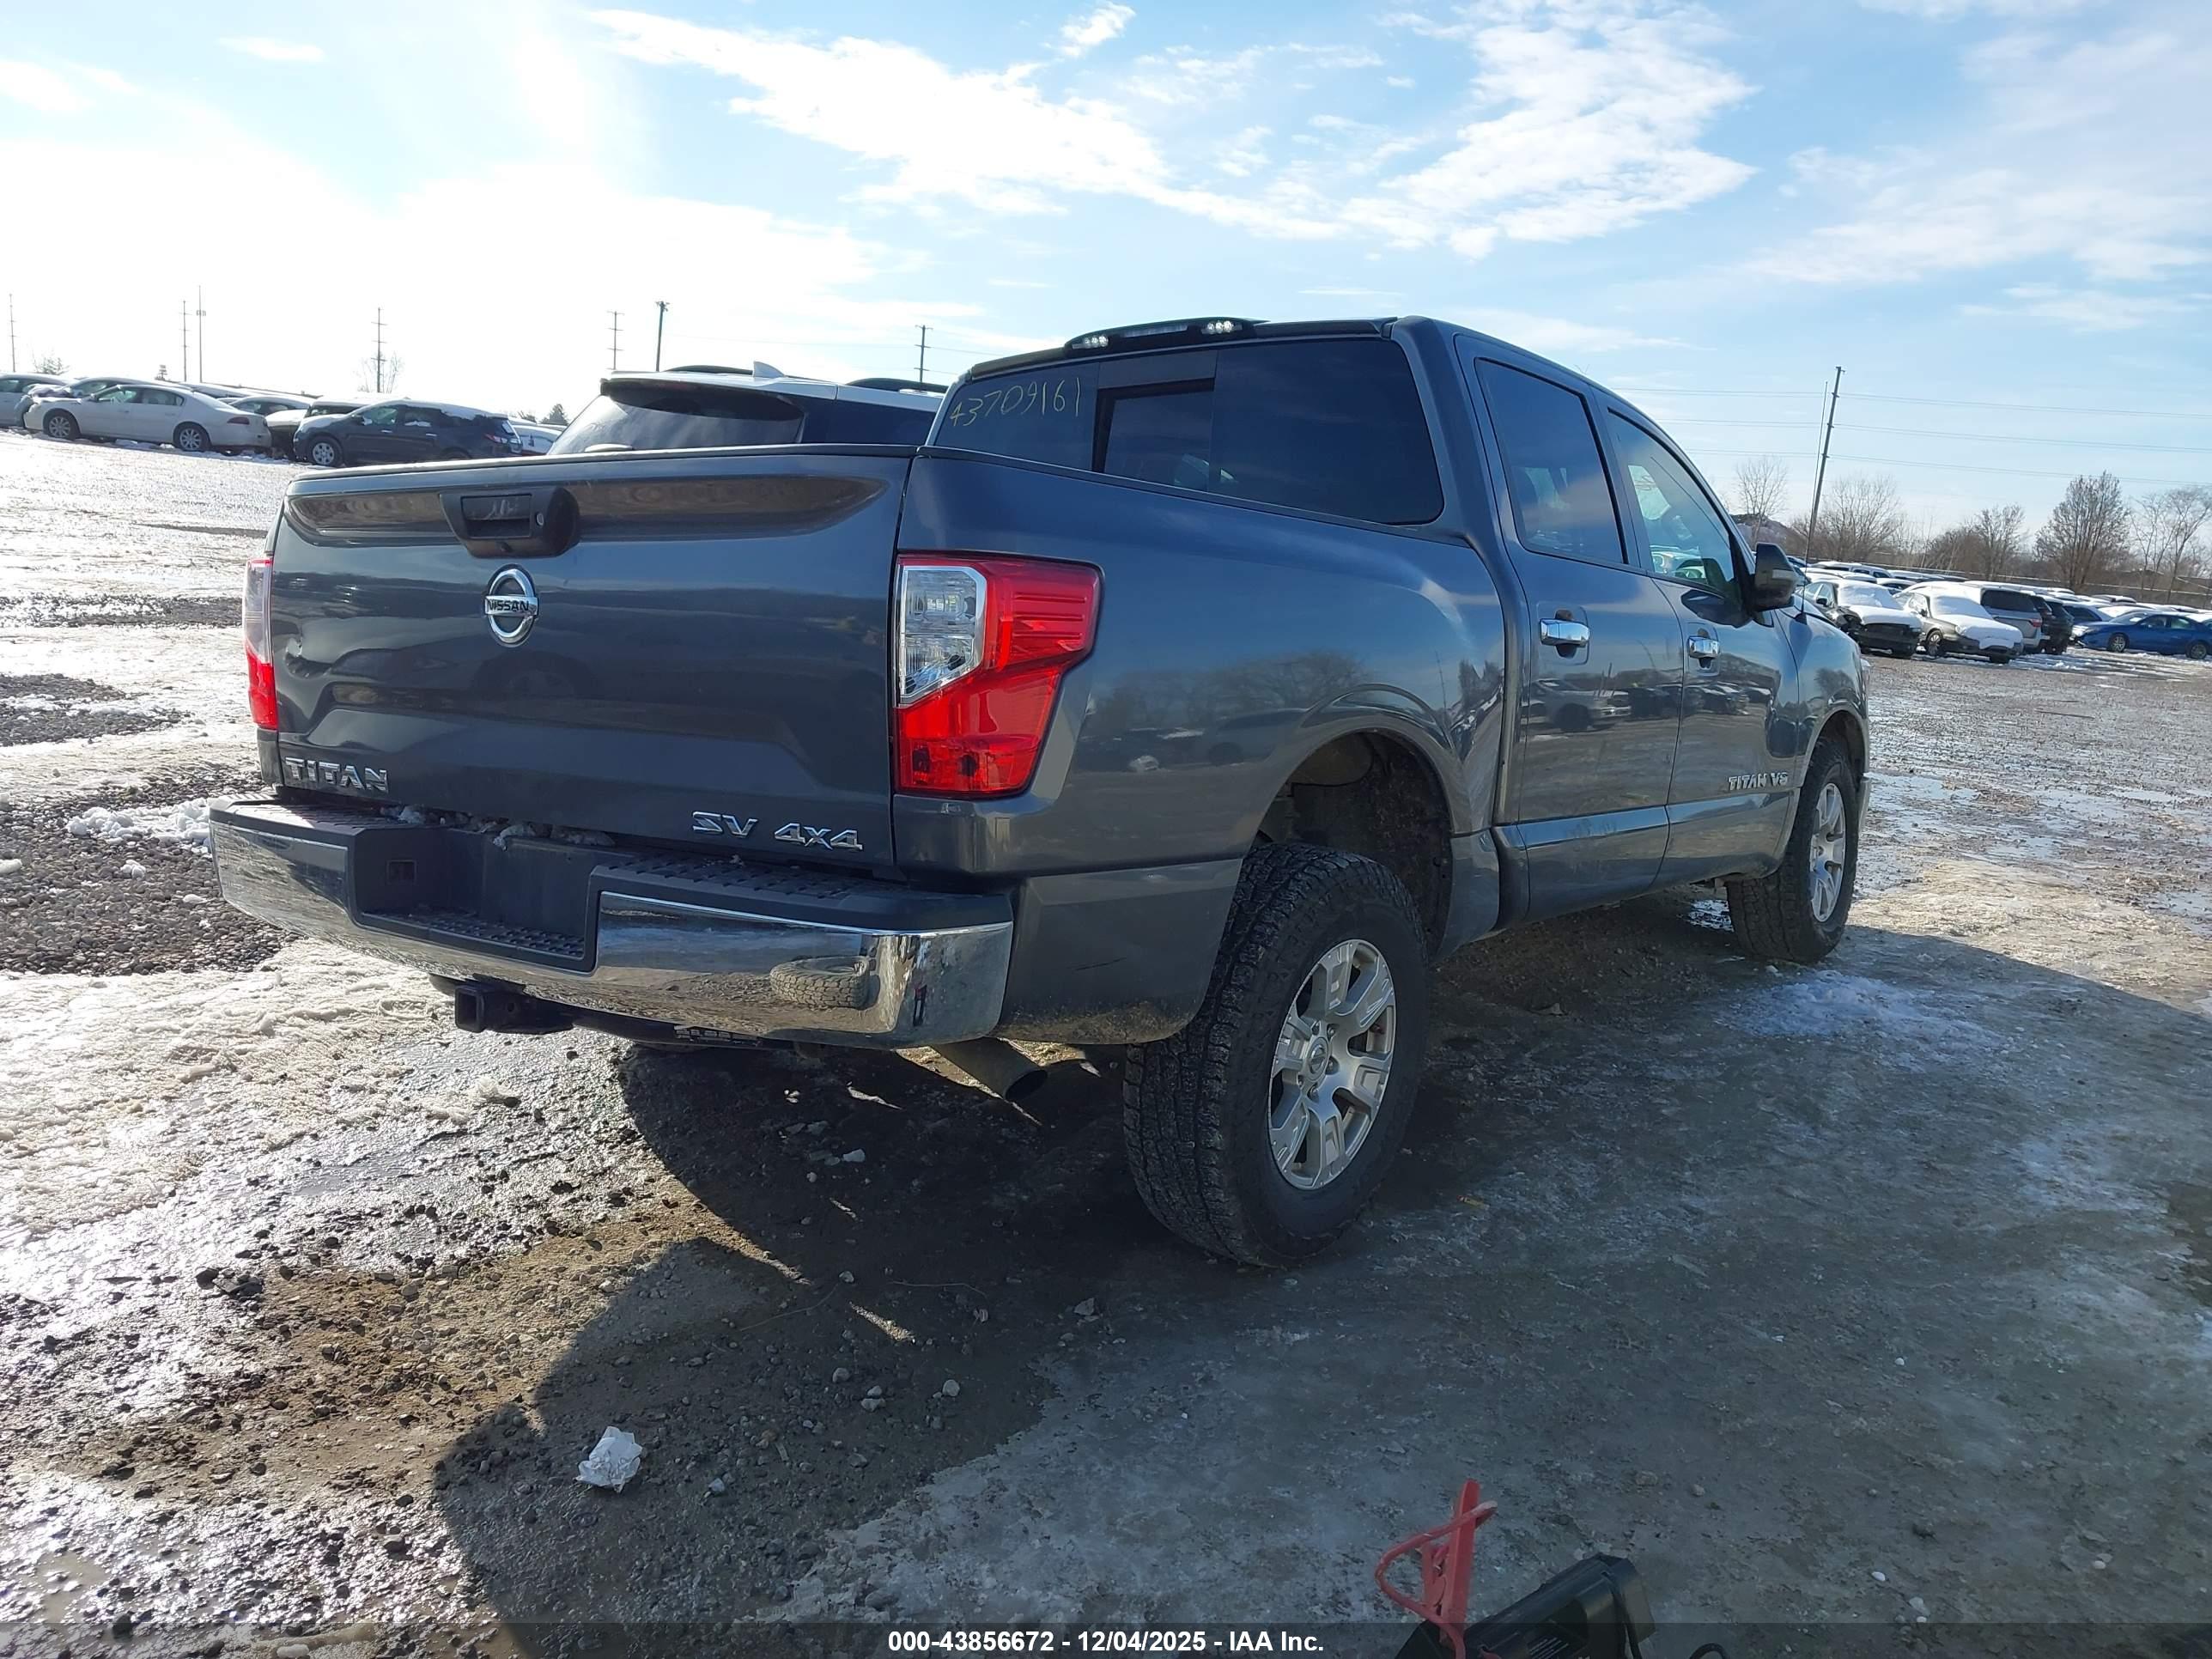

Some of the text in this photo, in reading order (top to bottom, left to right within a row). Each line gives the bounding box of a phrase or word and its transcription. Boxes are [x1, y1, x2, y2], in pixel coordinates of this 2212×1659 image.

[949, 377, 1080, 427] 43709161
[486, 599, 530, 612] NISSAN
[285, 757, 389, 793] TITAN
[1728, 773, 1768, 791] TITAN
[692, 811, 758, 837] SV
